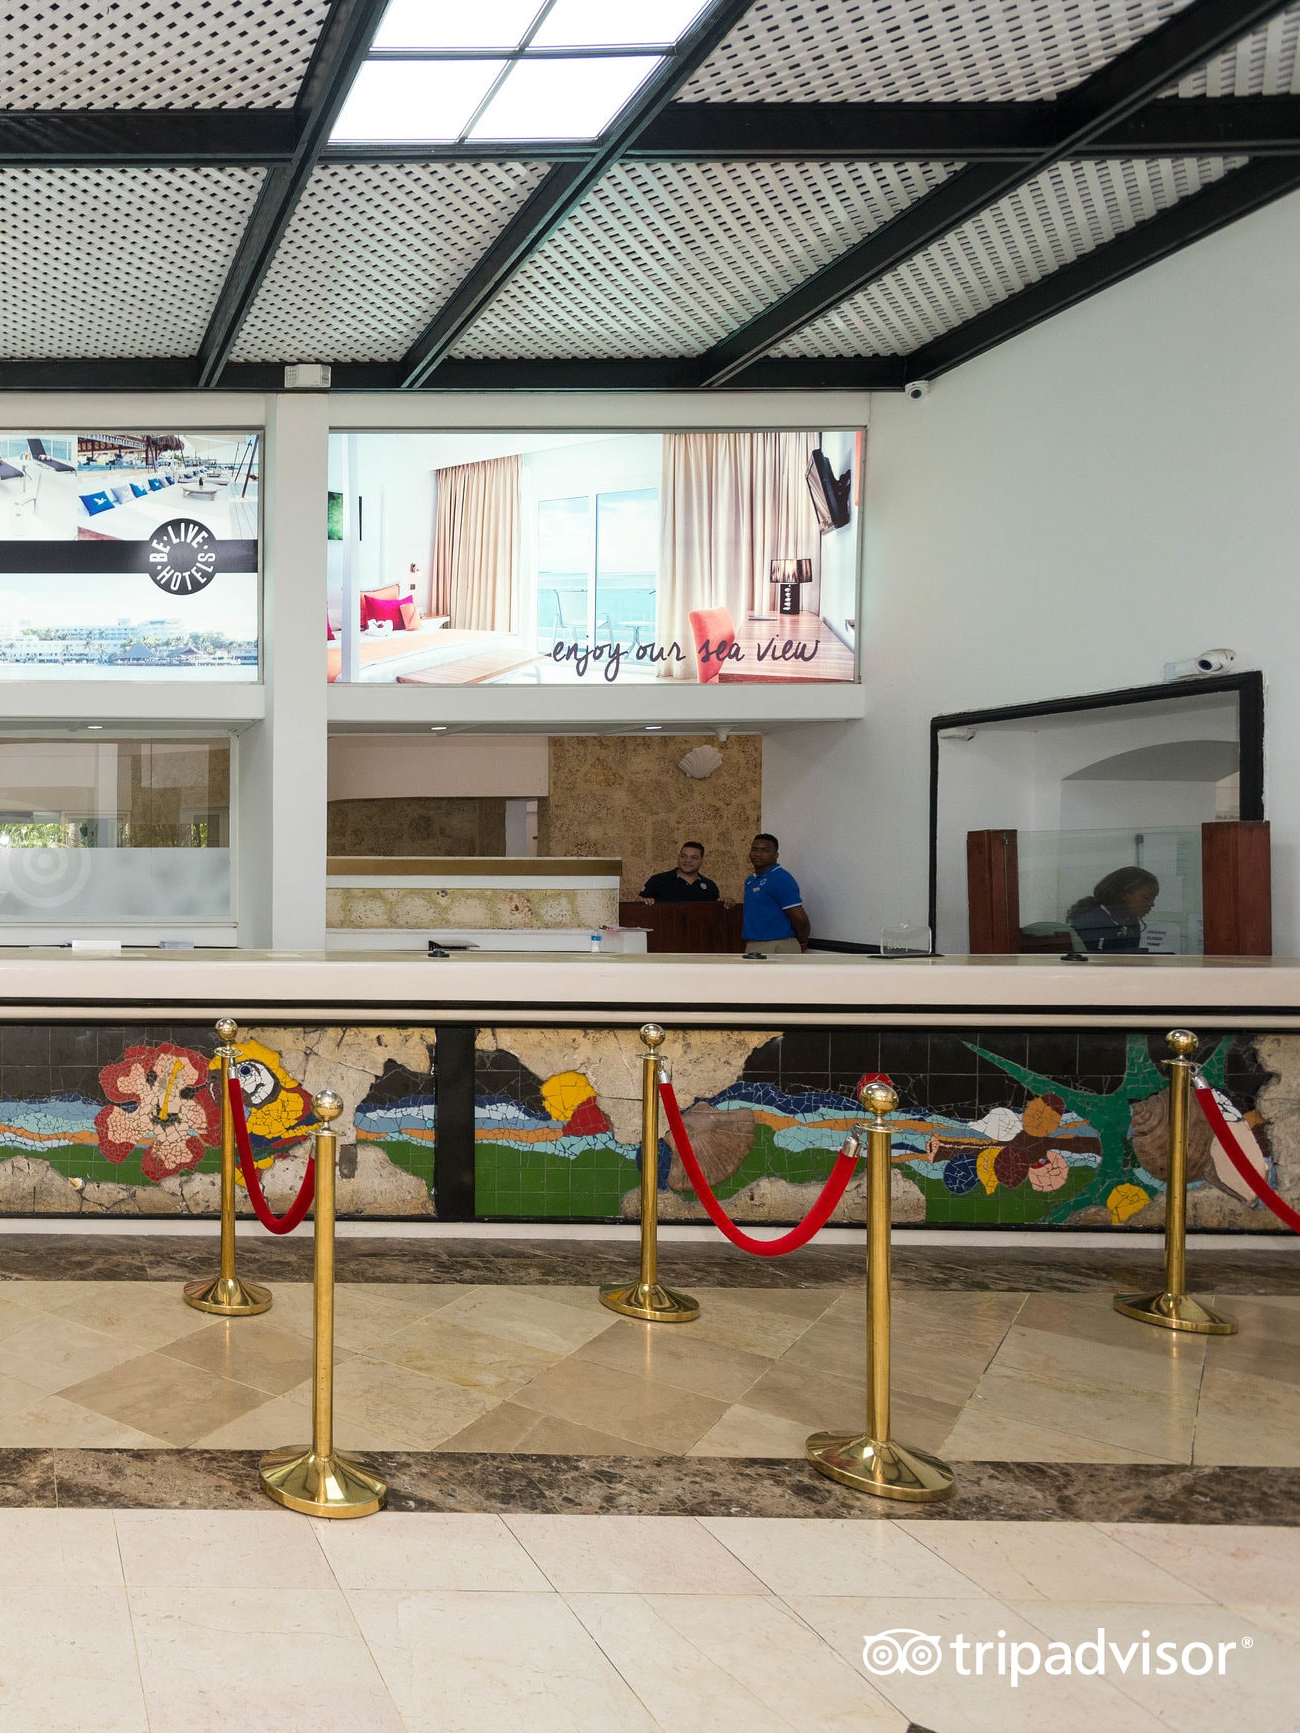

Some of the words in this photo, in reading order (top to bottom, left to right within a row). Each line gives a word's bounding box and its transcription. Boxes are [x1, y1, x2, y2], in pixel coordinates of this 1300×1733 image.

[149, 539, 171, 562] BE
[167, 522, 209, 549] LIVE
[156, 552, 216, 591] HOTELS
[552, 635, 628, 682] enjoy
[635, 640, 686, 662] our
[697, 638, 746, 663] sea
[756, 634, 821, 662] view
